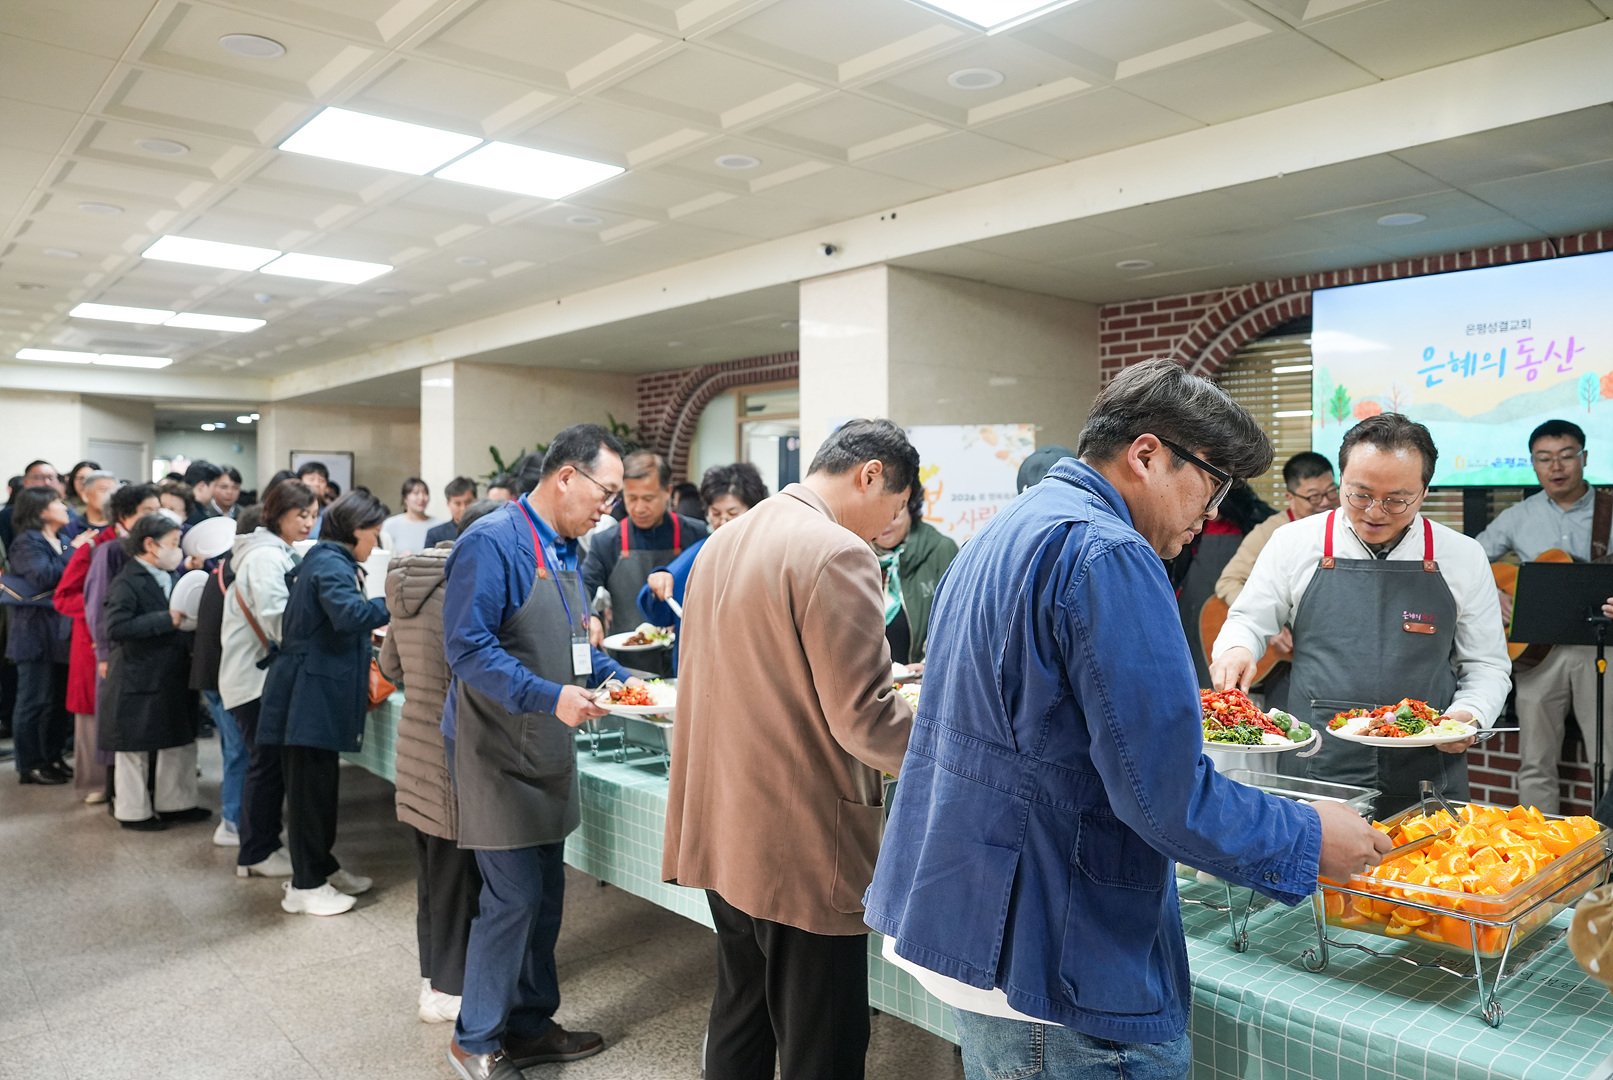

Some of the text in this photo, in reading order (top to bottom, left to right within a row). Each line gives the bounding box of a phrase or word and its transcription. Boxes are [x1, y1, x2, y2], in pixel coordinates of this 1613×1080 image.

[1466, 318, 1532, 336] 은평성결교회
[1417, 335, 1586, 388] 은혜의 동산
[1492, 456, 1534, 469] 은평교
[951, 493, 976, 502] 2026
